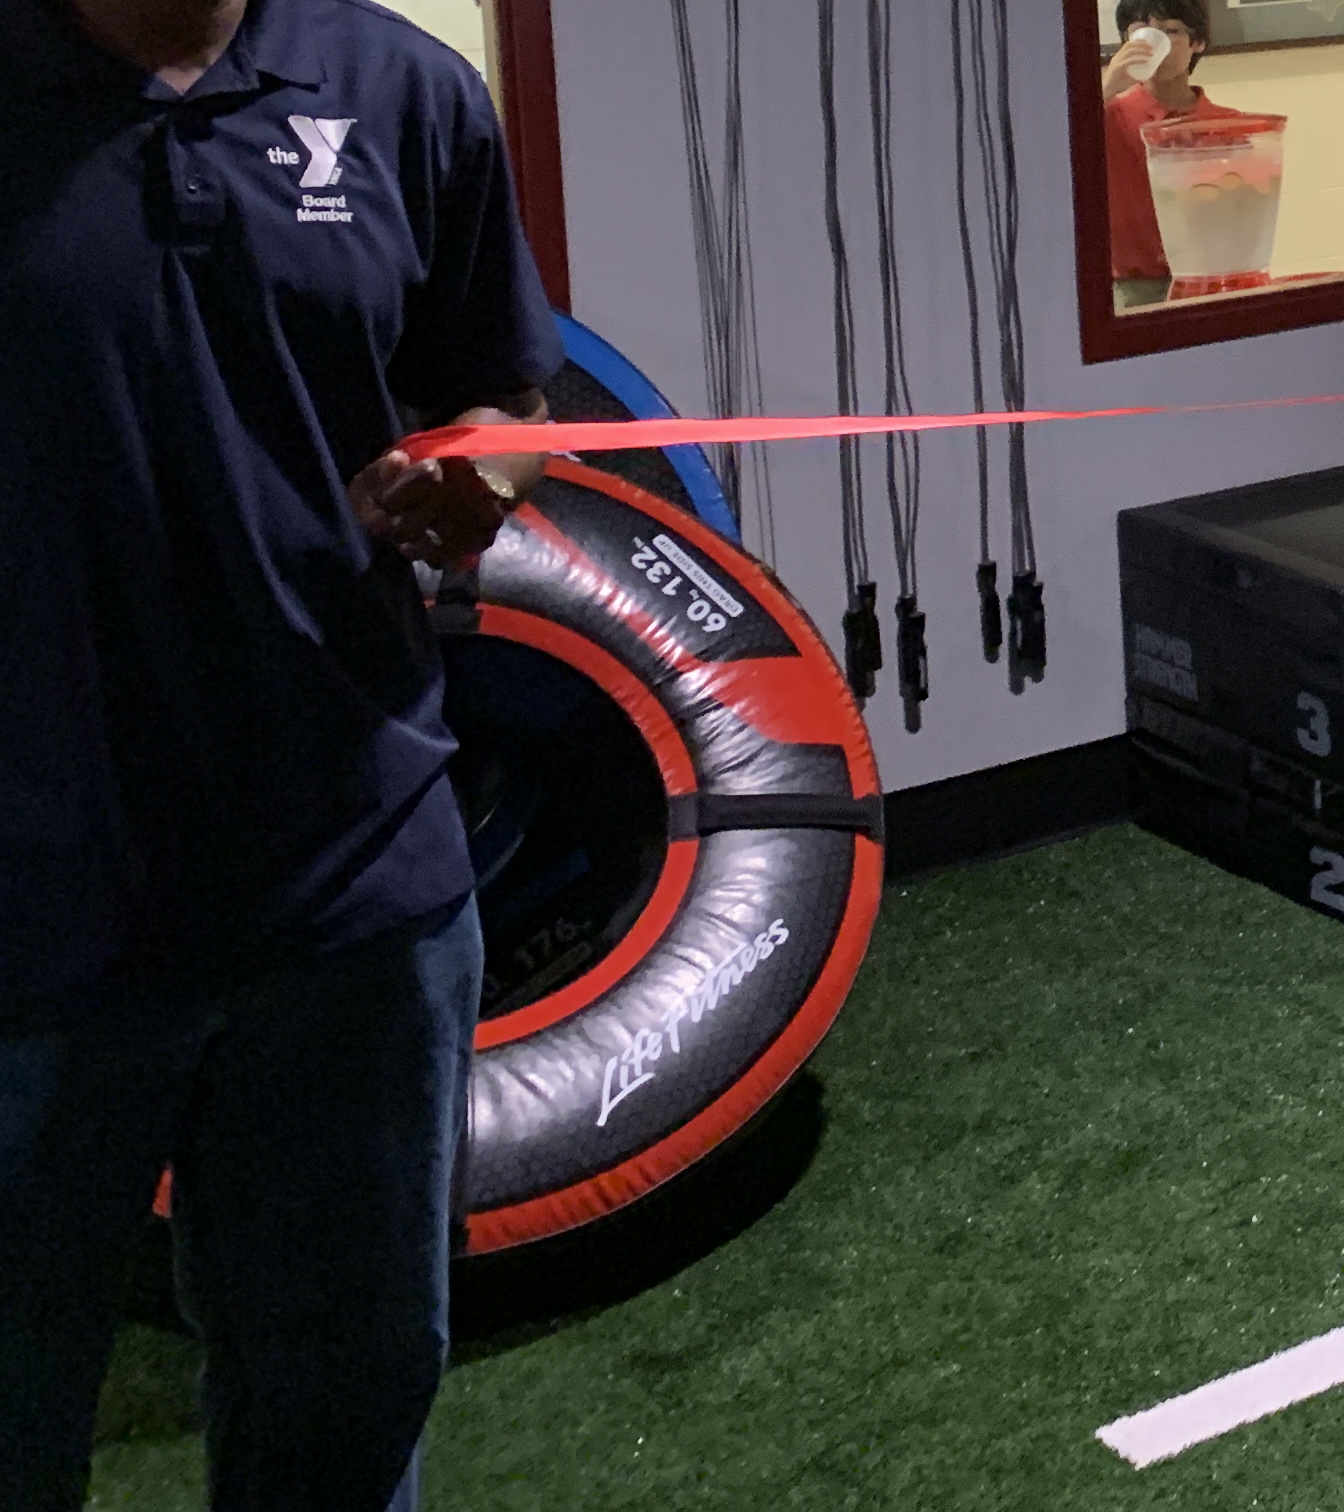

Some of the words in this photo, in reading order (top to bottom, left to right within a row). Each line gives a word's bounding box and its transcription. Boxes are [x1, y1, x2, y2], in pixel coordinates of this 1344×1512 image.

[266, 146, 300, 165] the
[301, 194, 347, 209] Board
[296, 208, 355, 223] Member
[672, 551, 694, 572] SIDE
[691, 568, 714, 590] THIS
[711, 587, 739, 614] DRAG
[1295, 690, 1333, 758] 3
[596, 1028, 663, 1127] Life
